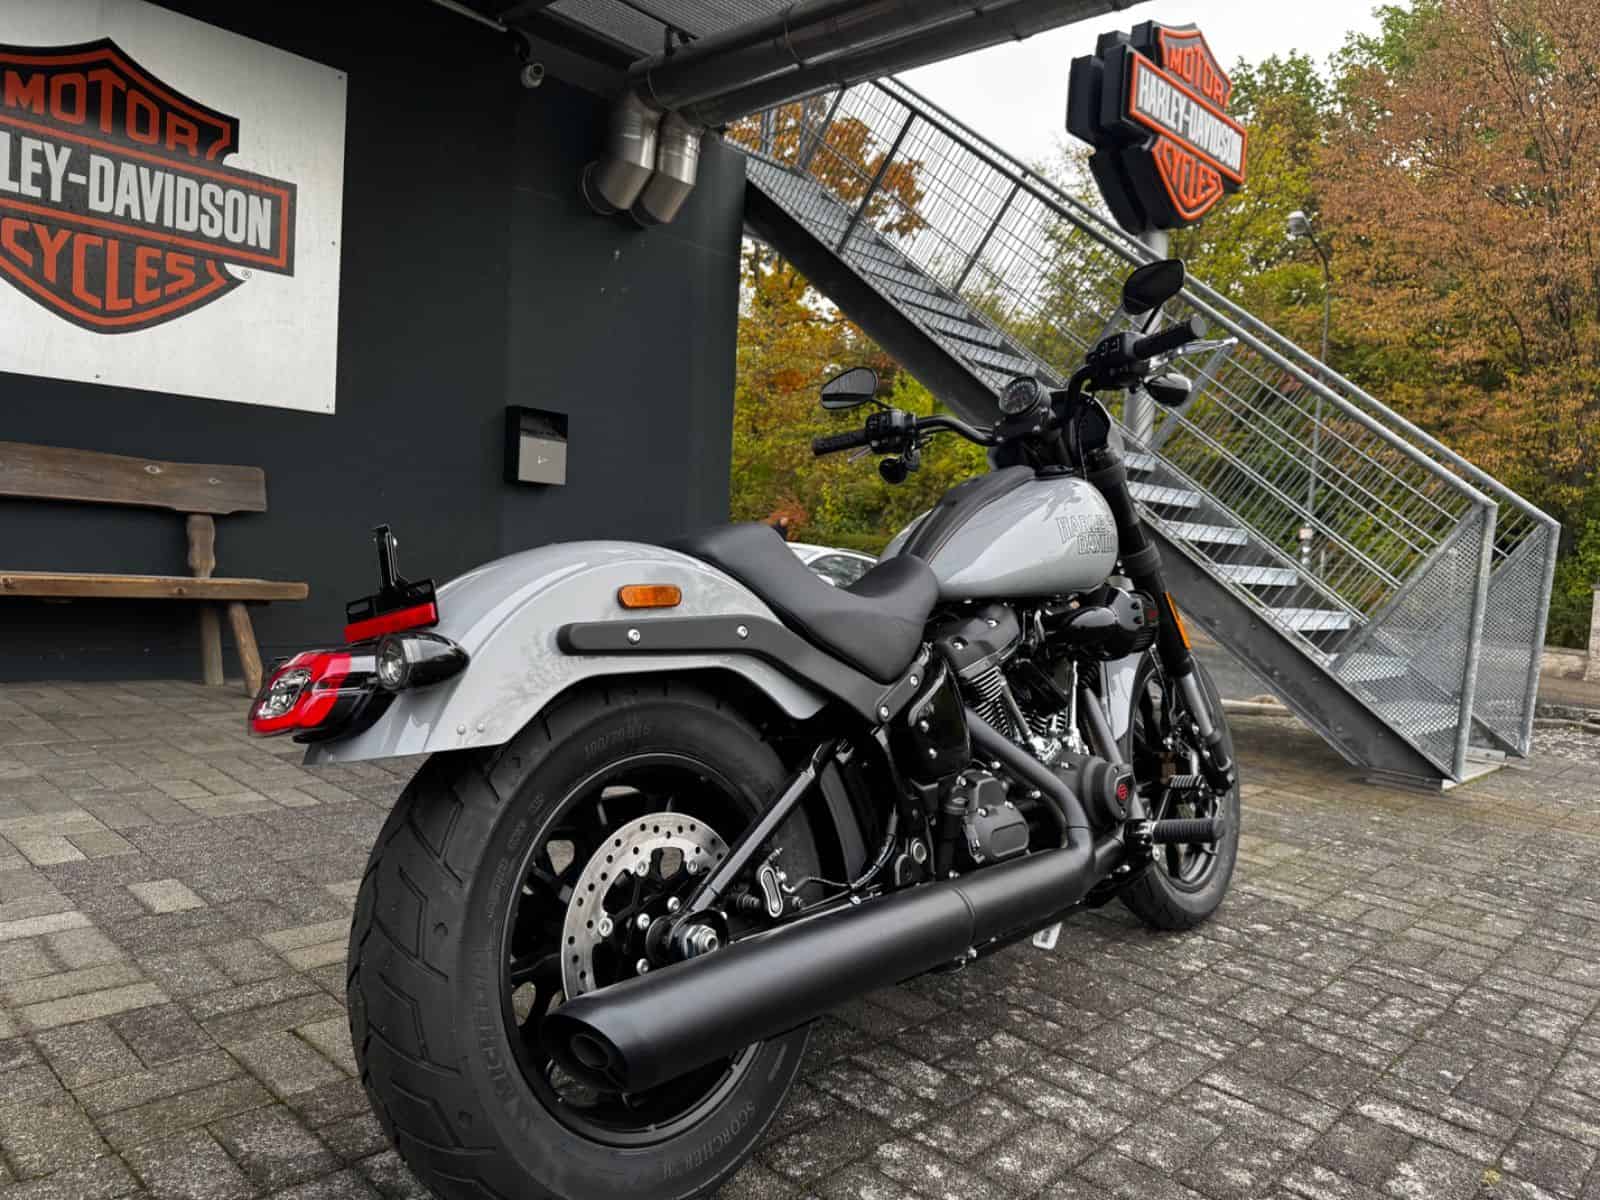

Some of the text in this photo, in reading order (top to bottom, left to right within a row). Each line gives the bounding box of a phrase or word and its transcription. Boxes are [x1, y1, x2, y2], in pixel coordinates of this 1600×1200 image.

[4, 67, 200, 157] MOTOR
[1137, 65, 1243, 172] HARLEY-DAVIDSON
[1168, 46, 1225, 103] MOTOR
[1162, 141, 1218, 209] CYCLES
[1, 216, 197, 312] CYCLES
